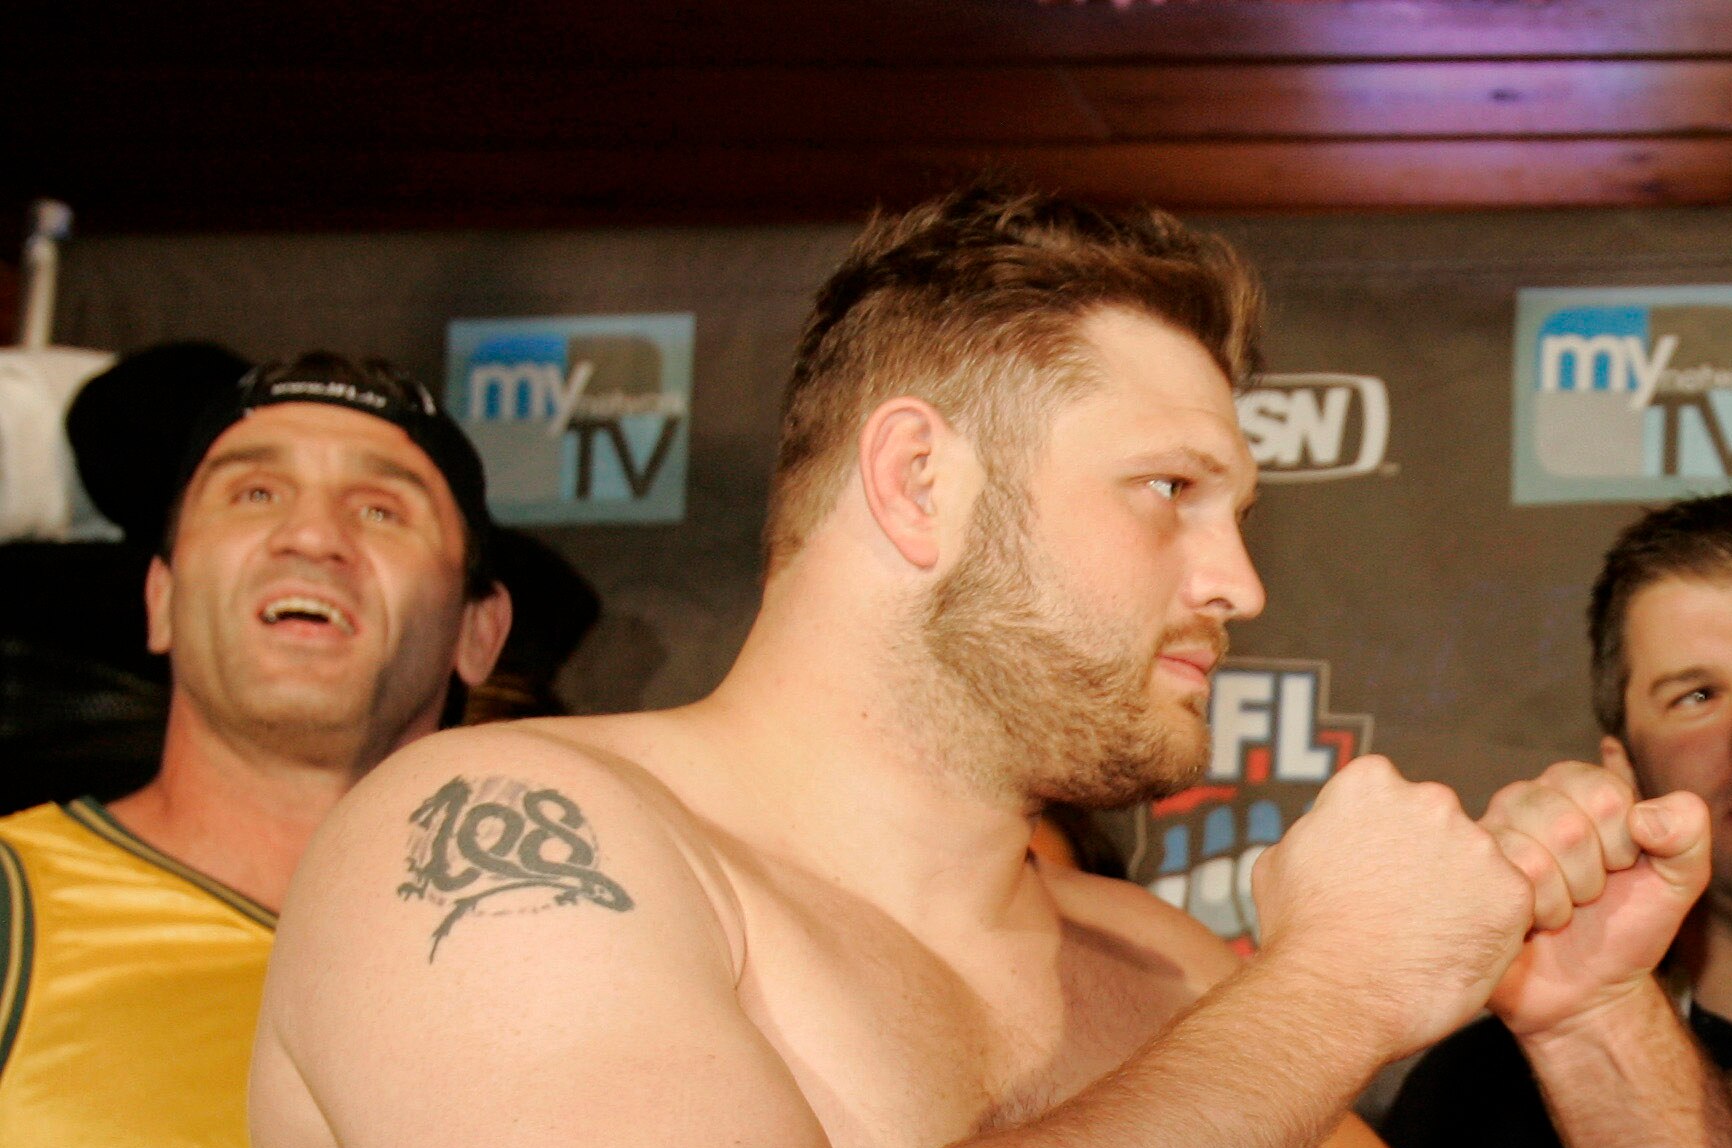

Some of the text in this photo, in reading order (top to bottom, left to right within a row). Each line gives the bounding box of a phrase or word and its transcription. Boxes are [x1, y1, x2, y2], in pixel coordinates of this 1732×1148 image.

[471, 360, 595, 438] my
[1541, 333, 1680, 411] my
[567, 413, 682, 499] TV
[1233, 387, 1350, 465] SN
[1208, 670, 1332, 783] FL
